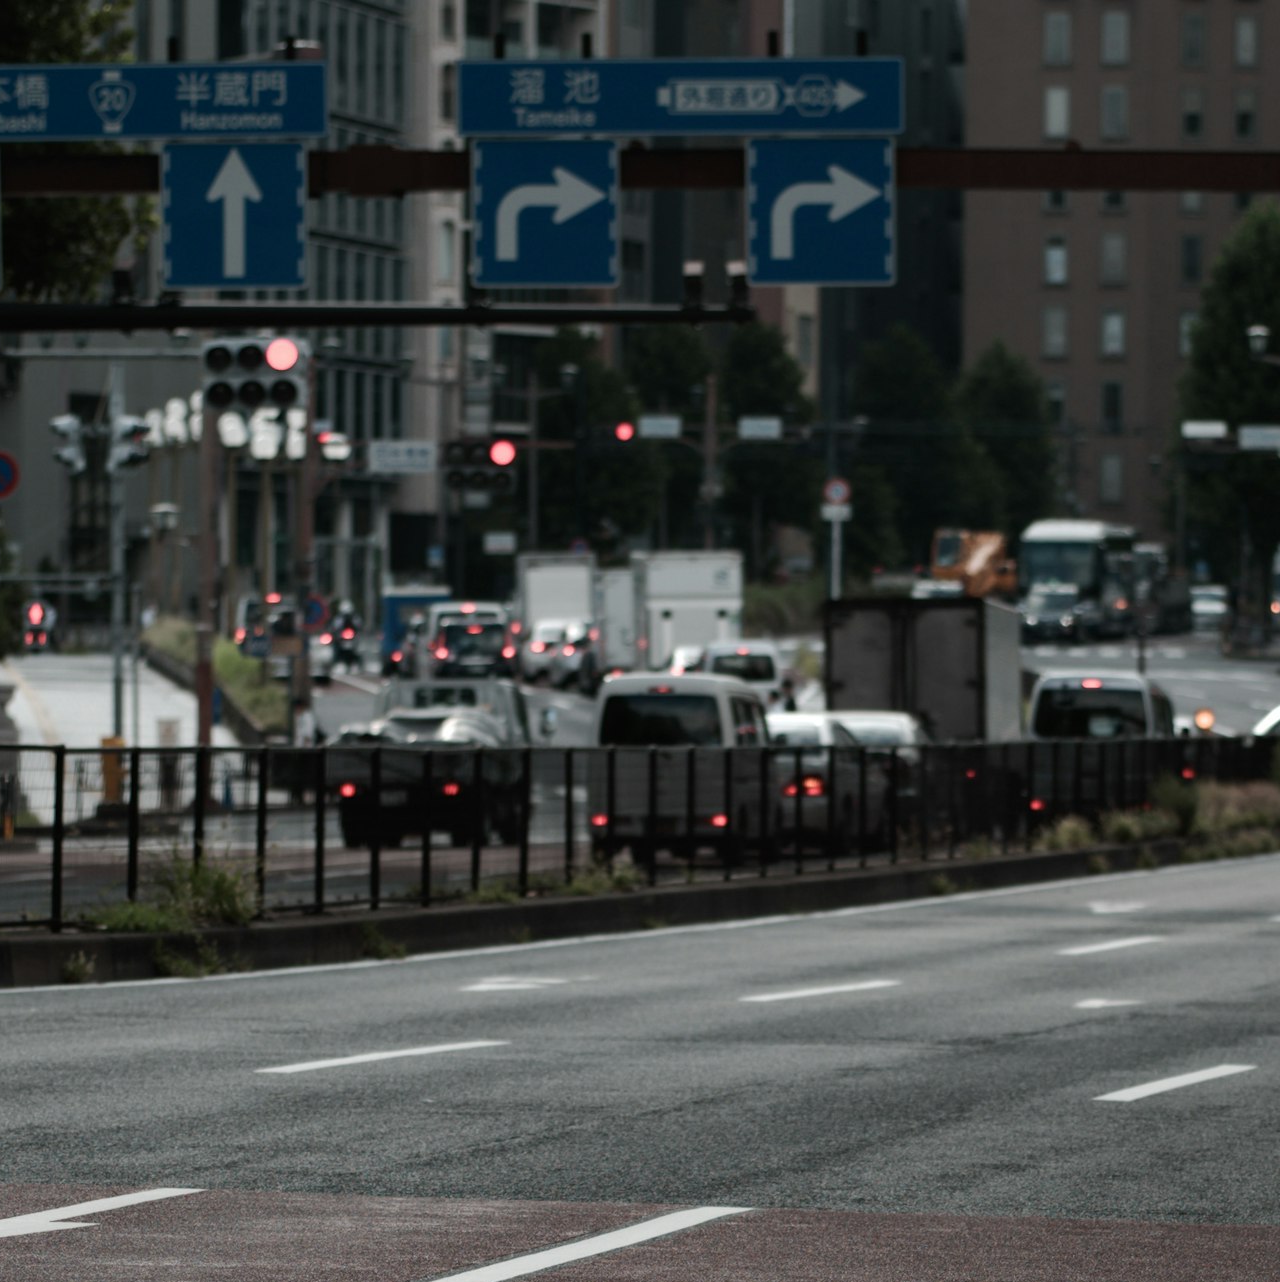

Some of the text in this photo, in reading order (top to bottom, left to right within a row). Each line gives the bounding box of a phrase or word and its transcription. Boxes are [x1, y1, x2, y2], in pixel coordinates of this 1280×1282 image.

[98, 87, 128, 112] 20
[175, 70, 288, 107] 半蔵門
[680, 84, 770, 108] 外堀通り
[180, 110, 284, 130] Hanzomon
[512, 106, 598, 128] Tameike
